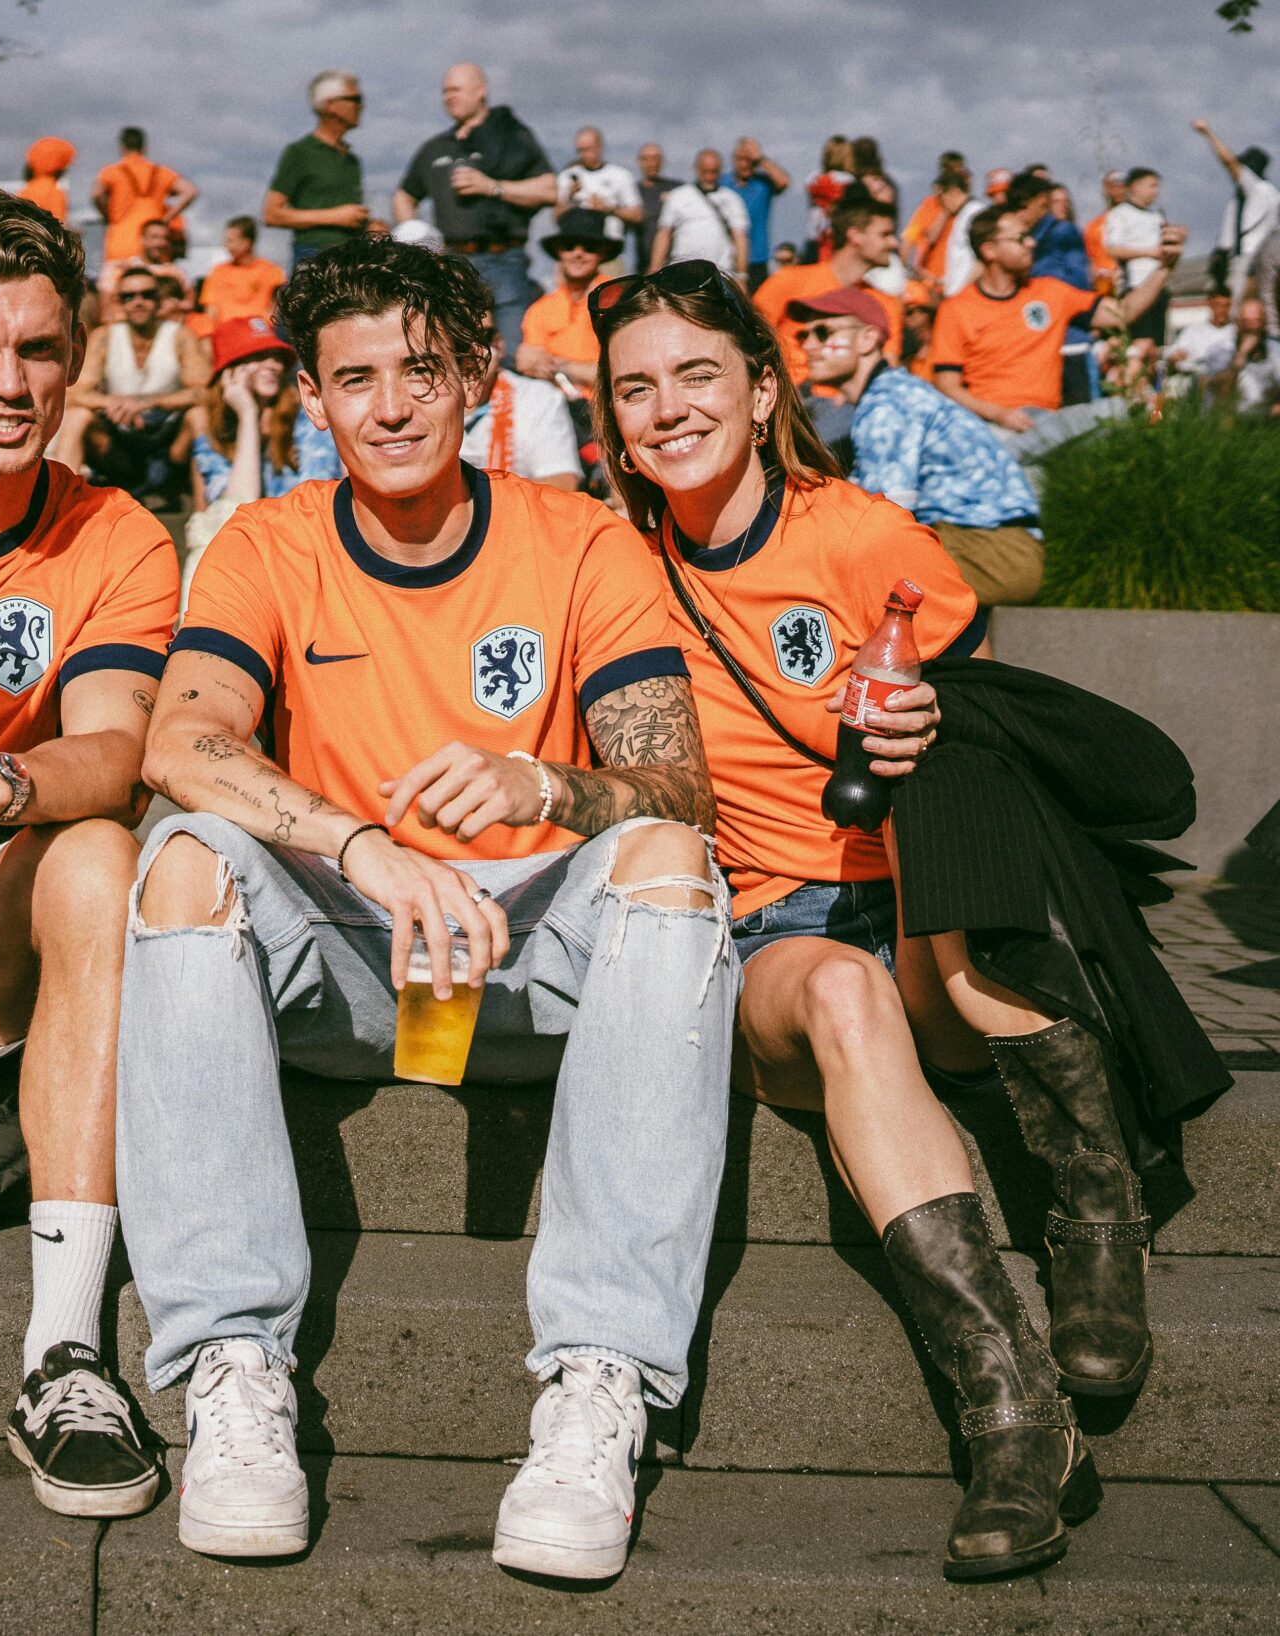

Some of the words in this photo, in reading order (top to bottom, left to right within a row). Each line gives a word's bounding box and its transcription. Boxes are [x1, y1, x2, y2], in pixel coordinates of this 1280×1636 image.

[3, 601, 28, 610] KNVB
[494, 630, 518, 640] KNVB
[68, 1347, 95, 1362] VANS
